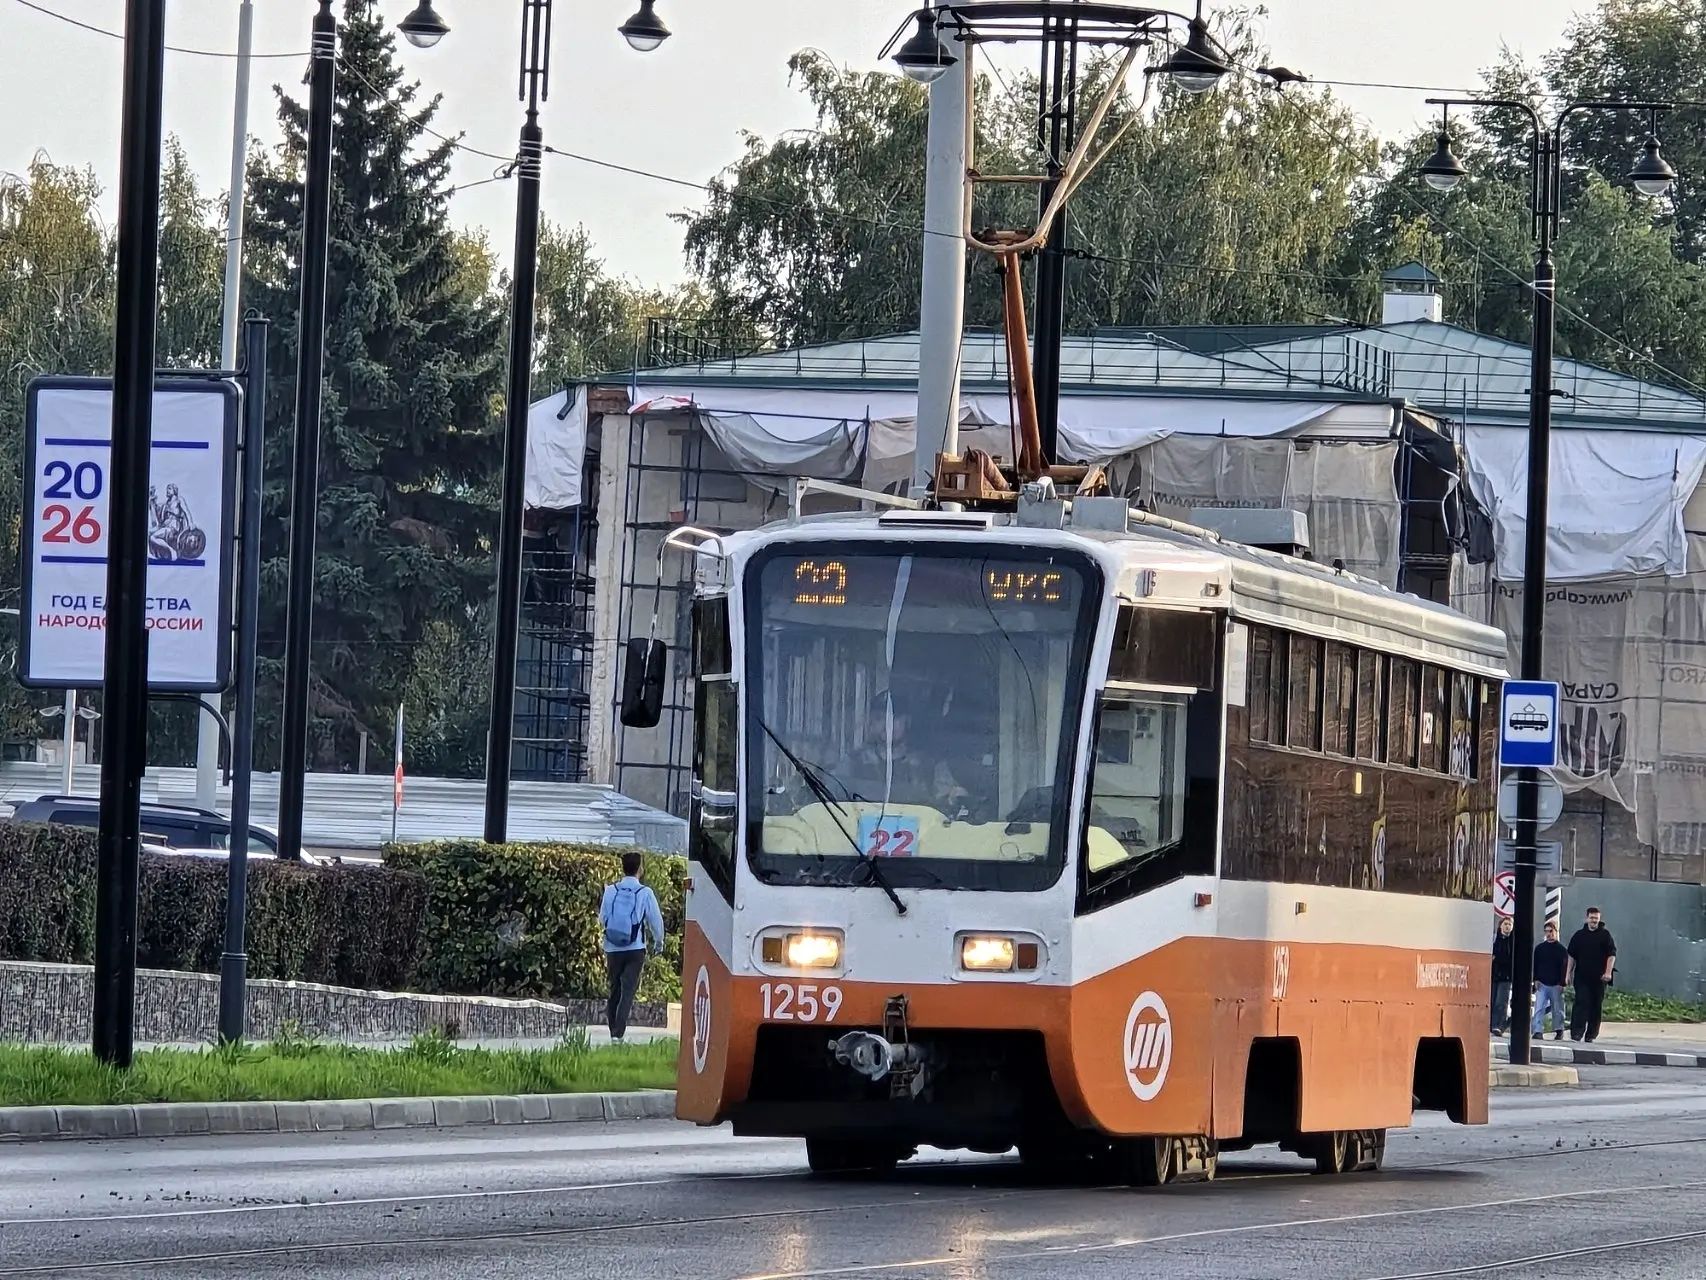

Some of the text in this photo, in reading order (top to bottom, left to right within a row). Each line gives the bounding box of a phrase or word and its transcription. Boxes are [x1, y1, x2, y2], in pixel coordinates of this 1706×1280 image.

[43, 460, 103, 500] 20
[41, 504, 102, 544] 26
[51, 595, 191, 611] ГОД ЕСТВА
[38, 614, 203, 631] НАРОД ОССИИ
[867, 829, 914, 859] 22
[760, 983, 843, 1022] 1259
